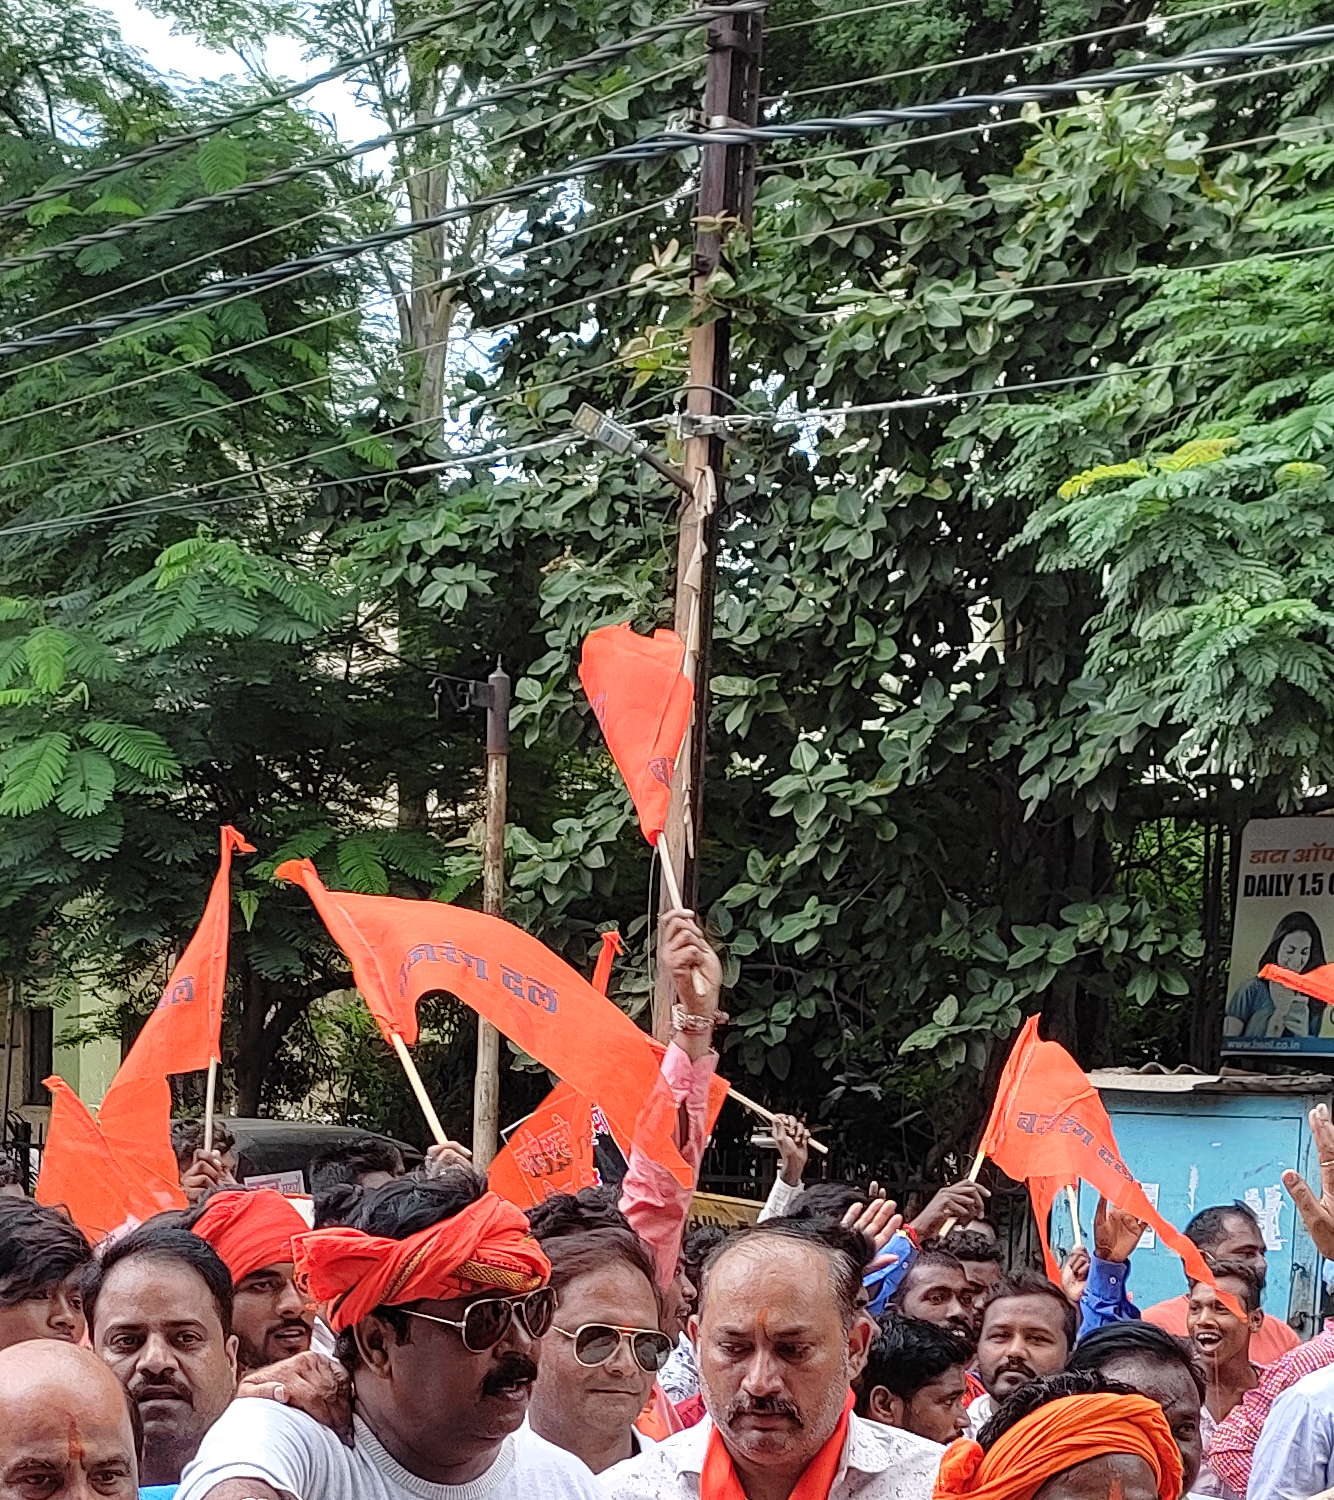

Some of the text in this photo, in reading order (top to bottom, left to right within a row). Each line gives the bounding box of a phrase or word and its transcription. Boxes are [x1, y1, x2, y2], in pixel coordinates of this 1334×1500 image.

[1243, 872, 1294, 897] DAILY
[1298, 872, 1324, 896] 1.5
[500, 964, 559, 1014] दल
